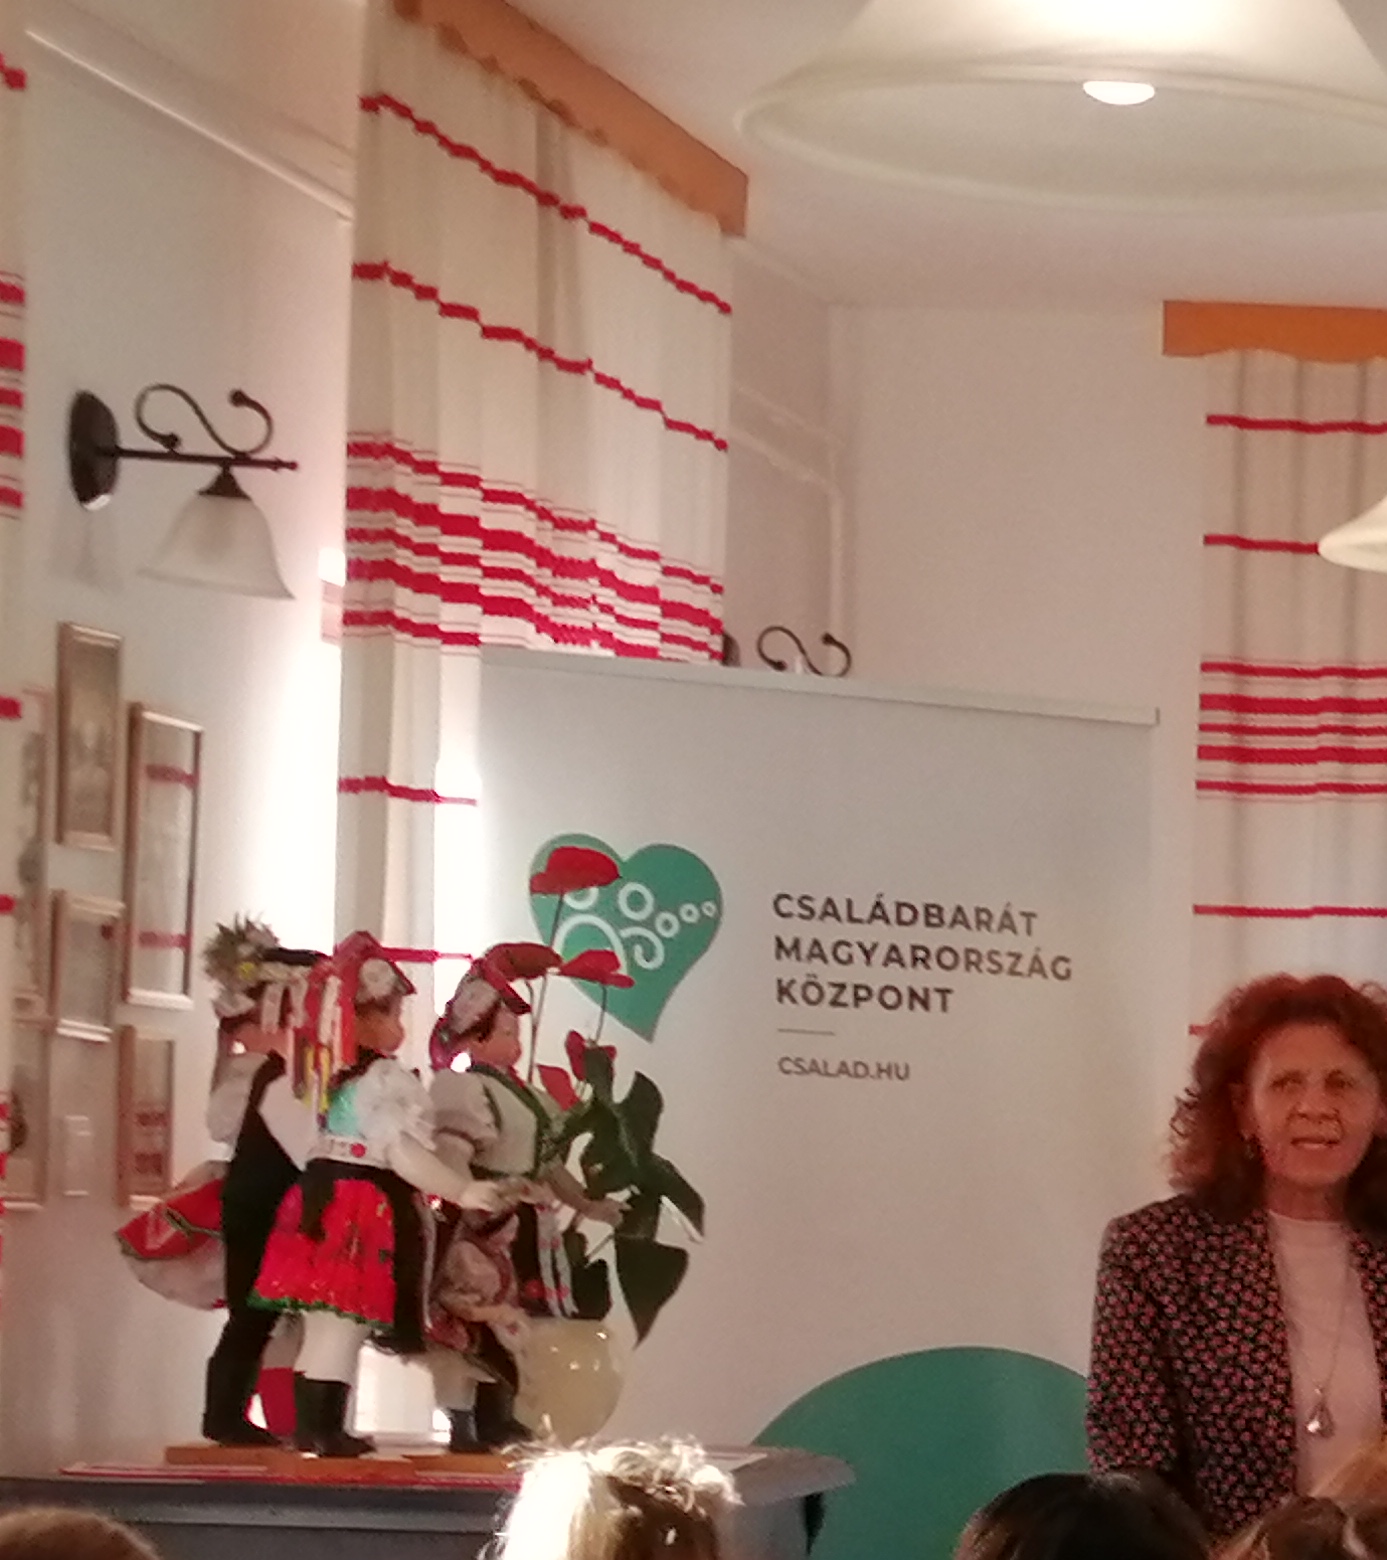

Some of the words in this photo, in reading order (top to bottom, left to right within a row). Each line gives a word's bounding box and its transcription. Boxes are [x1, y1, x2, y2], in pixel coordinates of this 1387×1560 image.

[773, 892, 1038, 937] CSALÁDBARÁT
[774, 936, 1073, 981] MAGYARORSZÁG
[776, 973, 955, 1013] KÖZPONT
[778, 1056, 911, 1081] CSALAD.HU
